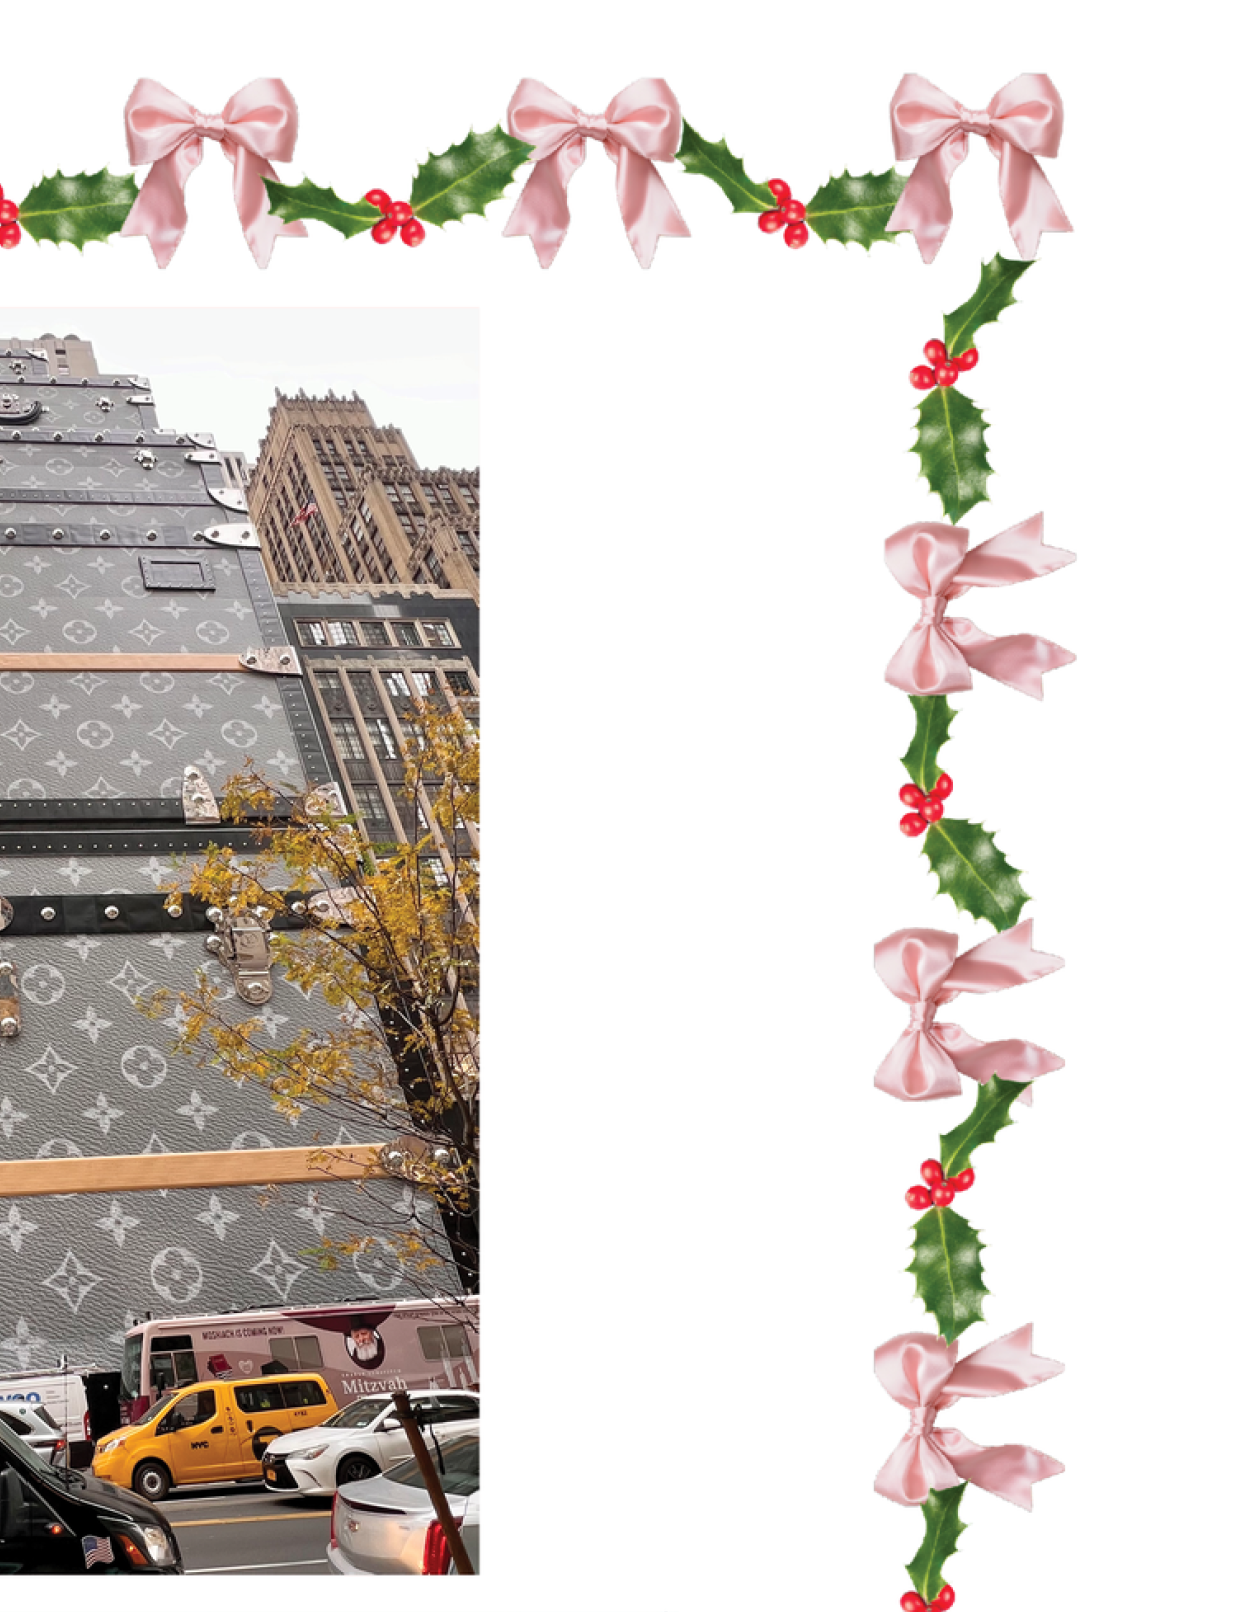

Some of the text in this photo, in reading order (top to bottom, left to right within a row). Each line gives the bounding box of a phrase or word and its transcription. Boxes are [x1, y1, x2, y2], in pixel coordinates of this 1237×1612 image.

[202, 1329, 235, 1340] MOSHIACH
[236, 1328, 243, 1338] IS
[243, 1326, 267, 1338] COMING
[341, 1376, 408, 1395] Mitzvah
[190, 1441, 210, 1449] NYC
